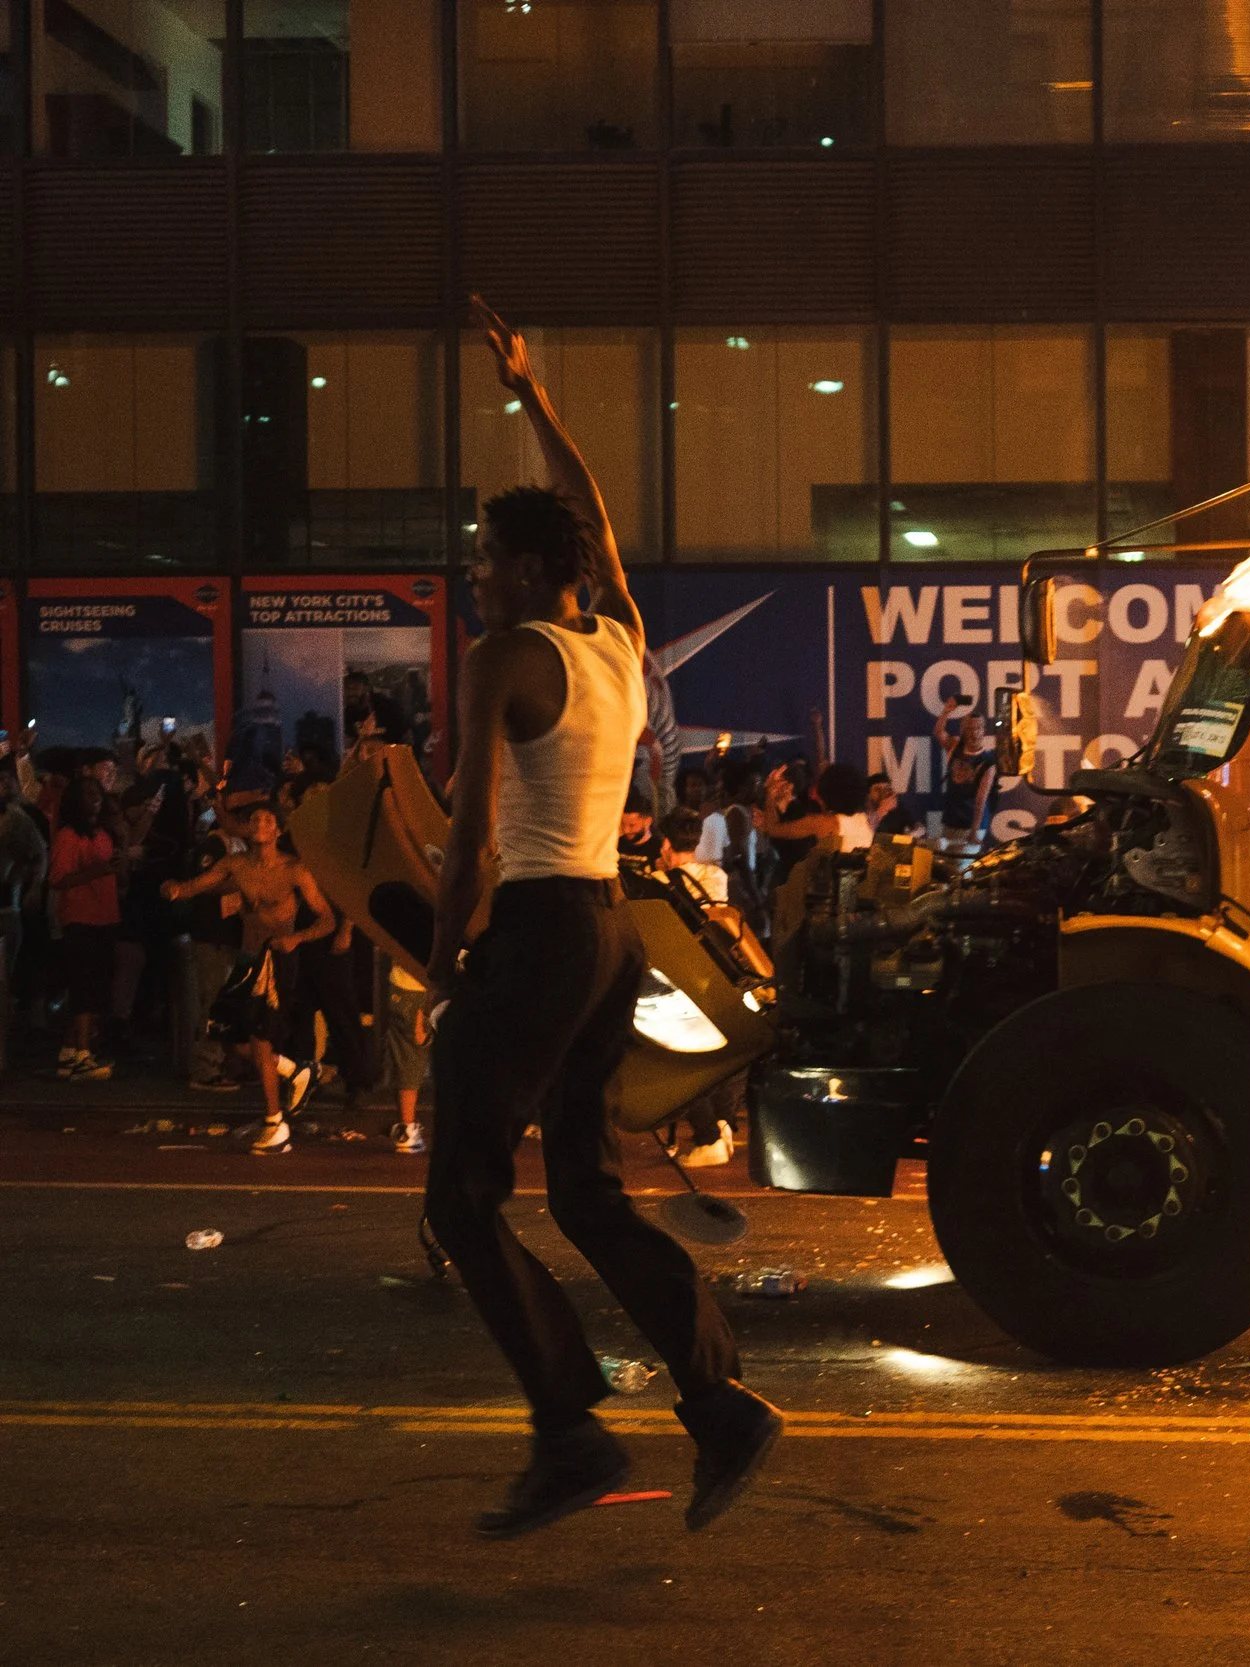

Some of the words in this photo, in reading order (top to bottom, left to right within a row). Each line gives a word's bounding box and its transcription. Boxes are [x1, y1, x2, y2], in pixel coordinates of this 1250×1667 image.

[250, 596, 286, 608] NEW
[291, 595, 332, 607] YORK
[335, 594, 385, 607] CITY'S
[40, 605, 136, 617] SIGHTSEEING
[250, 611, 281, 623] TOP
[284, 609, 391, 622] ATTRACTIONS
[40, 620, 102, 632] CRUISES
